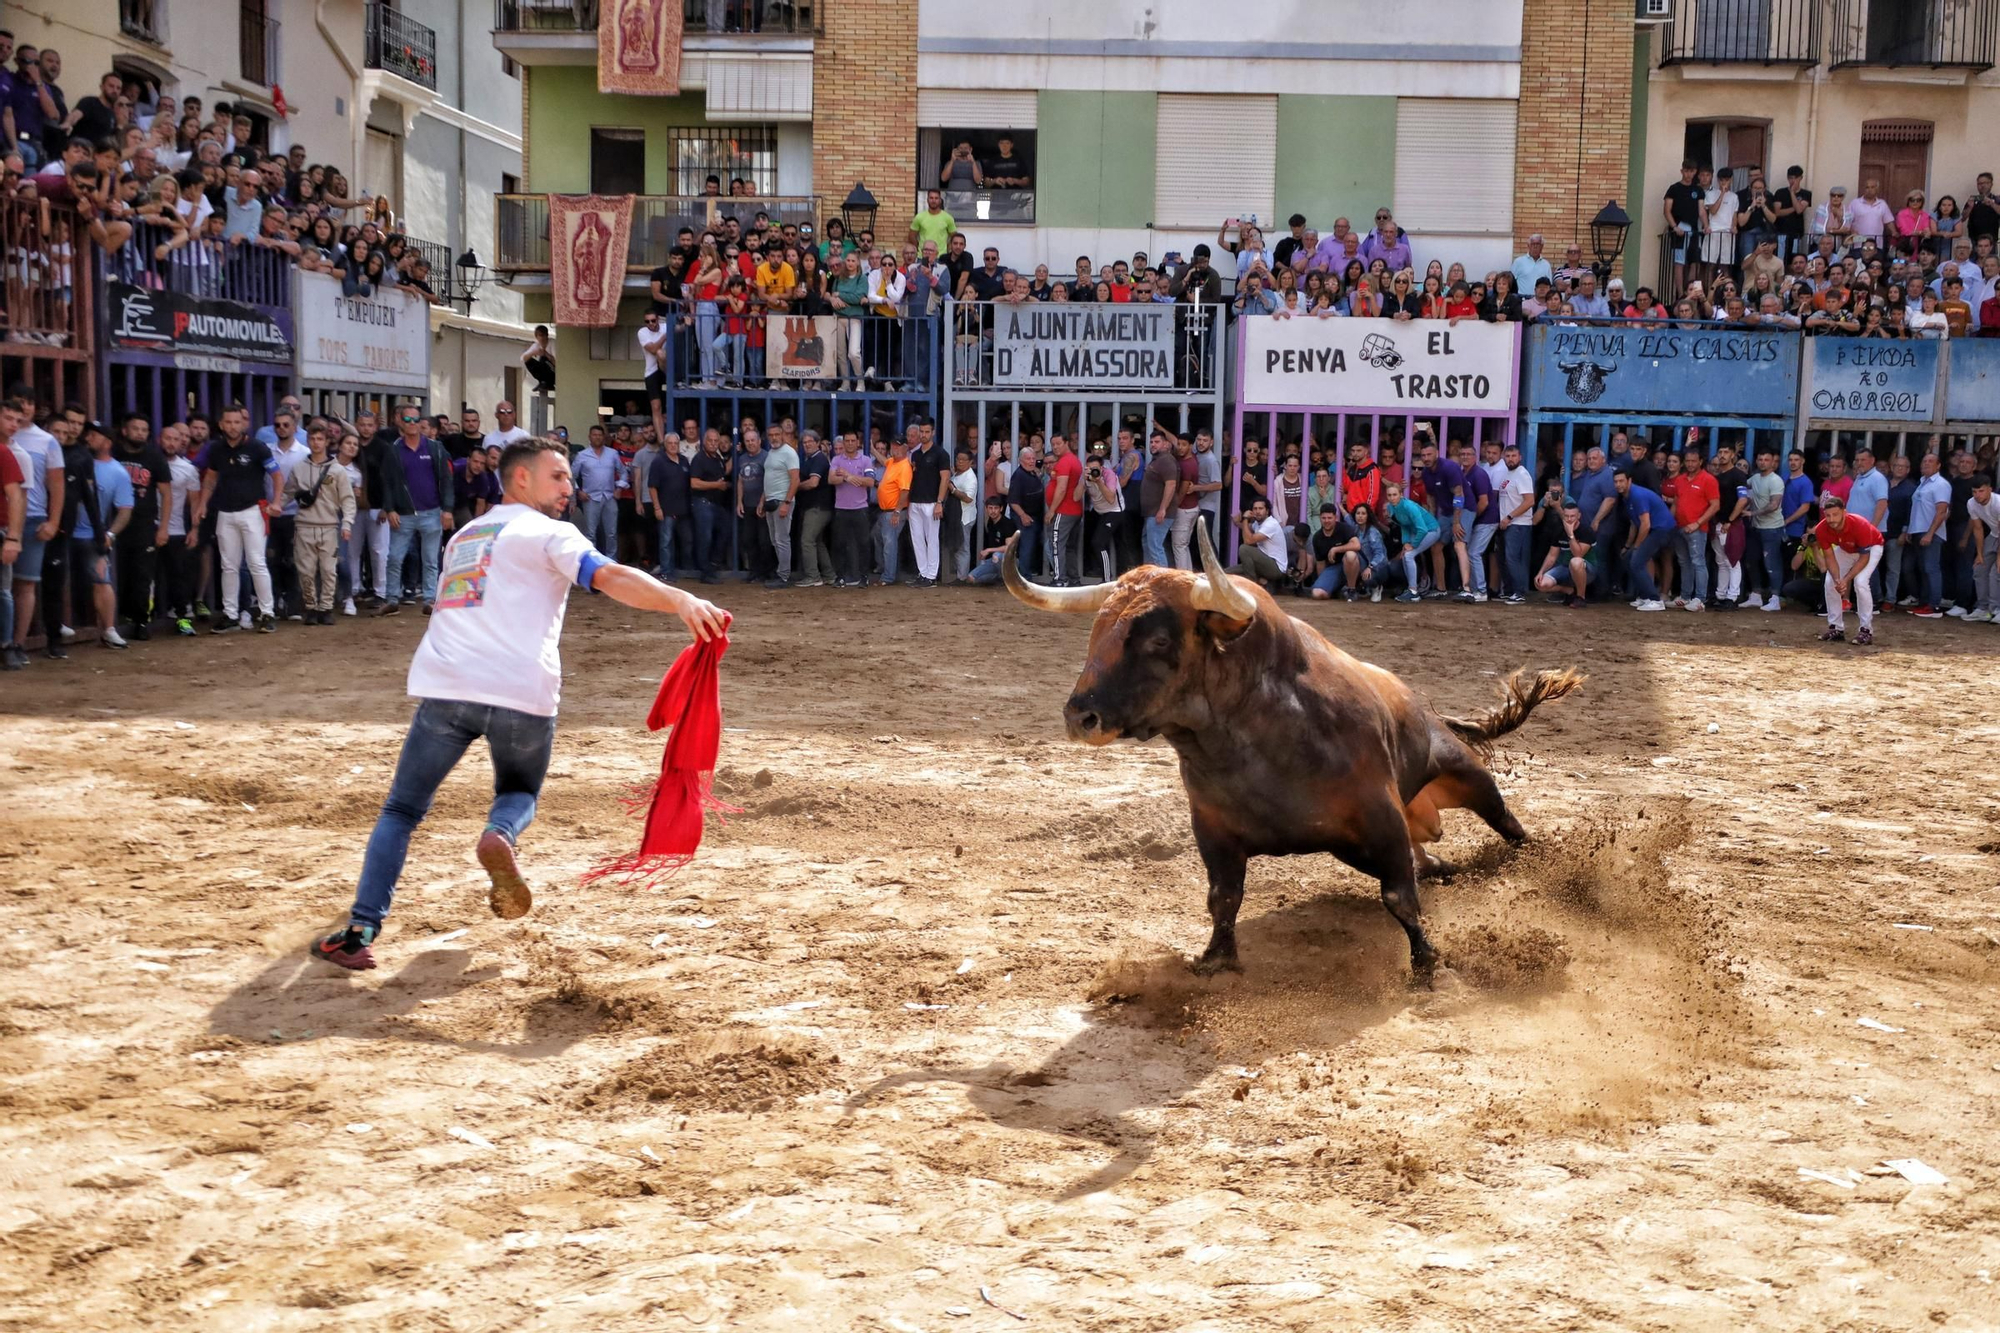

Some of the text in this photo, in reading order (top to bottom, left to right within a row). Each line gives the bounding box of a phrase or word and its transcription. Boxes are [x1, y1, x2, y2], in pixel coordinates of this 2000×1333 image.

[1007, 311, 1163, 342] AJUNTAMENT
[1427, 331, 1455, 356] EL
[1553, 333, 1626, 359] PENYA
[1638, 335, 1682, 359] ELS
[1029, 348, 1170, 378] ALMASSORA
[1265, 347, 1347, 374] PENYA
[1390, 374, 1490, 399] TRASTO
